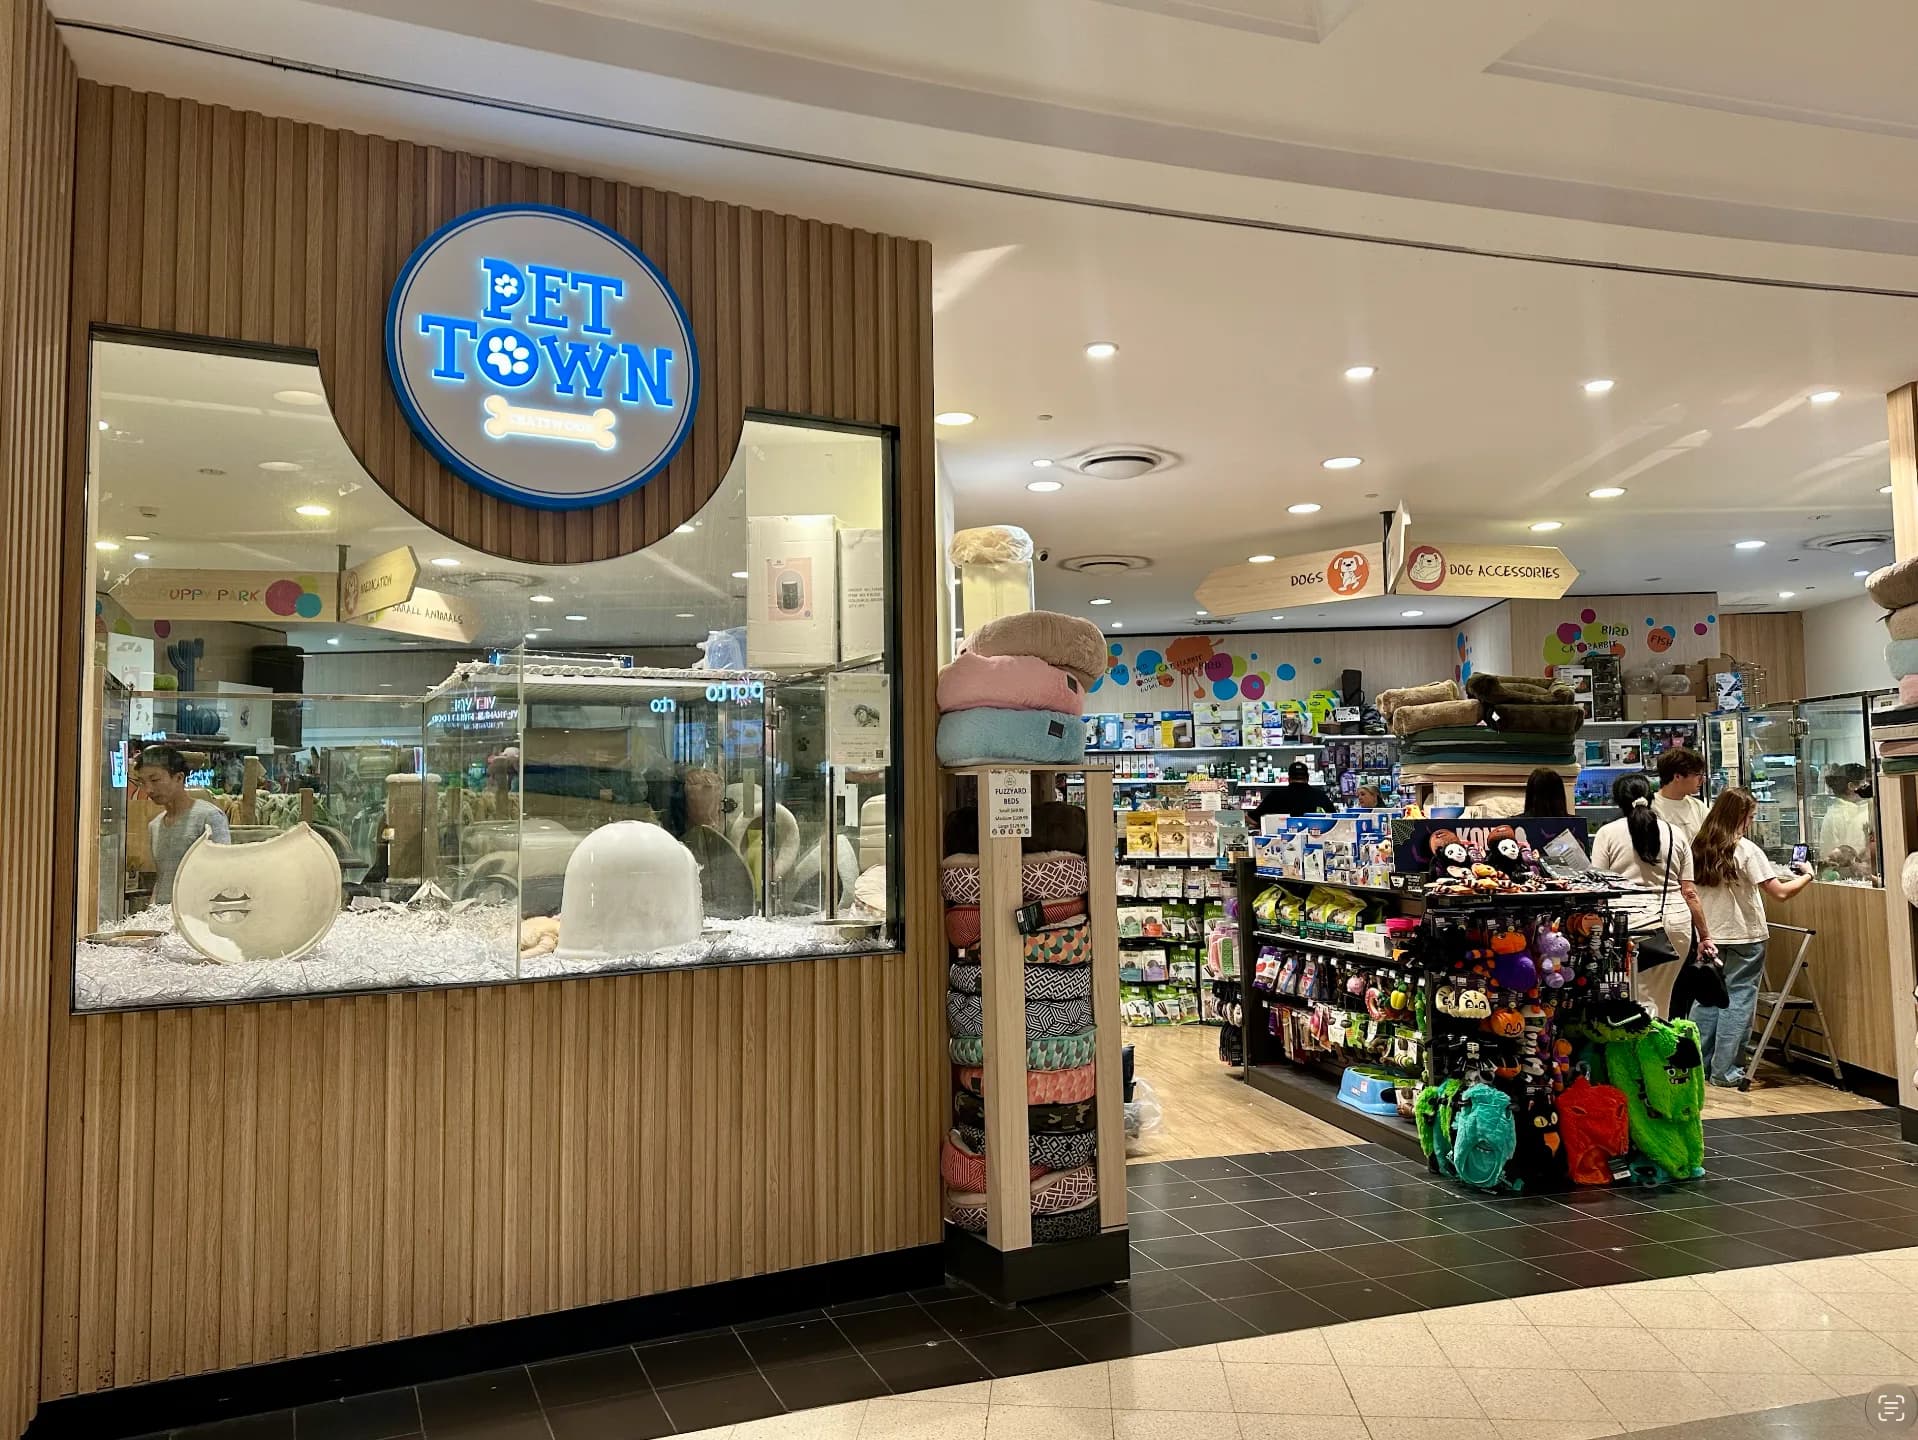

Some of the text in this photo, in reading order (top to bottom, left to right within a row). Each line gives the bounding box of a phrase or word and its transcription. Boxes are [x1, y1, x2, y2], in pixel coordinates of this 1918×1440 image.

[481, 257, 624, 336] PET
[419, 313, 674, 408] TOWN
[1290, 571, 1324, 587] DOGS
[1449, 563, 1561, 580] DOG ACCESSORIES
[163, 588, 208, 601] UPP
[425, 608, 464, 625] ANIMALS
[1601, 624, 1630, 637] BIRD
[1650, 634, 1674, 647] FISH
[995, 787, 1027, 795] FUZZYARD
[1456, 827, 1500, 851] KON
